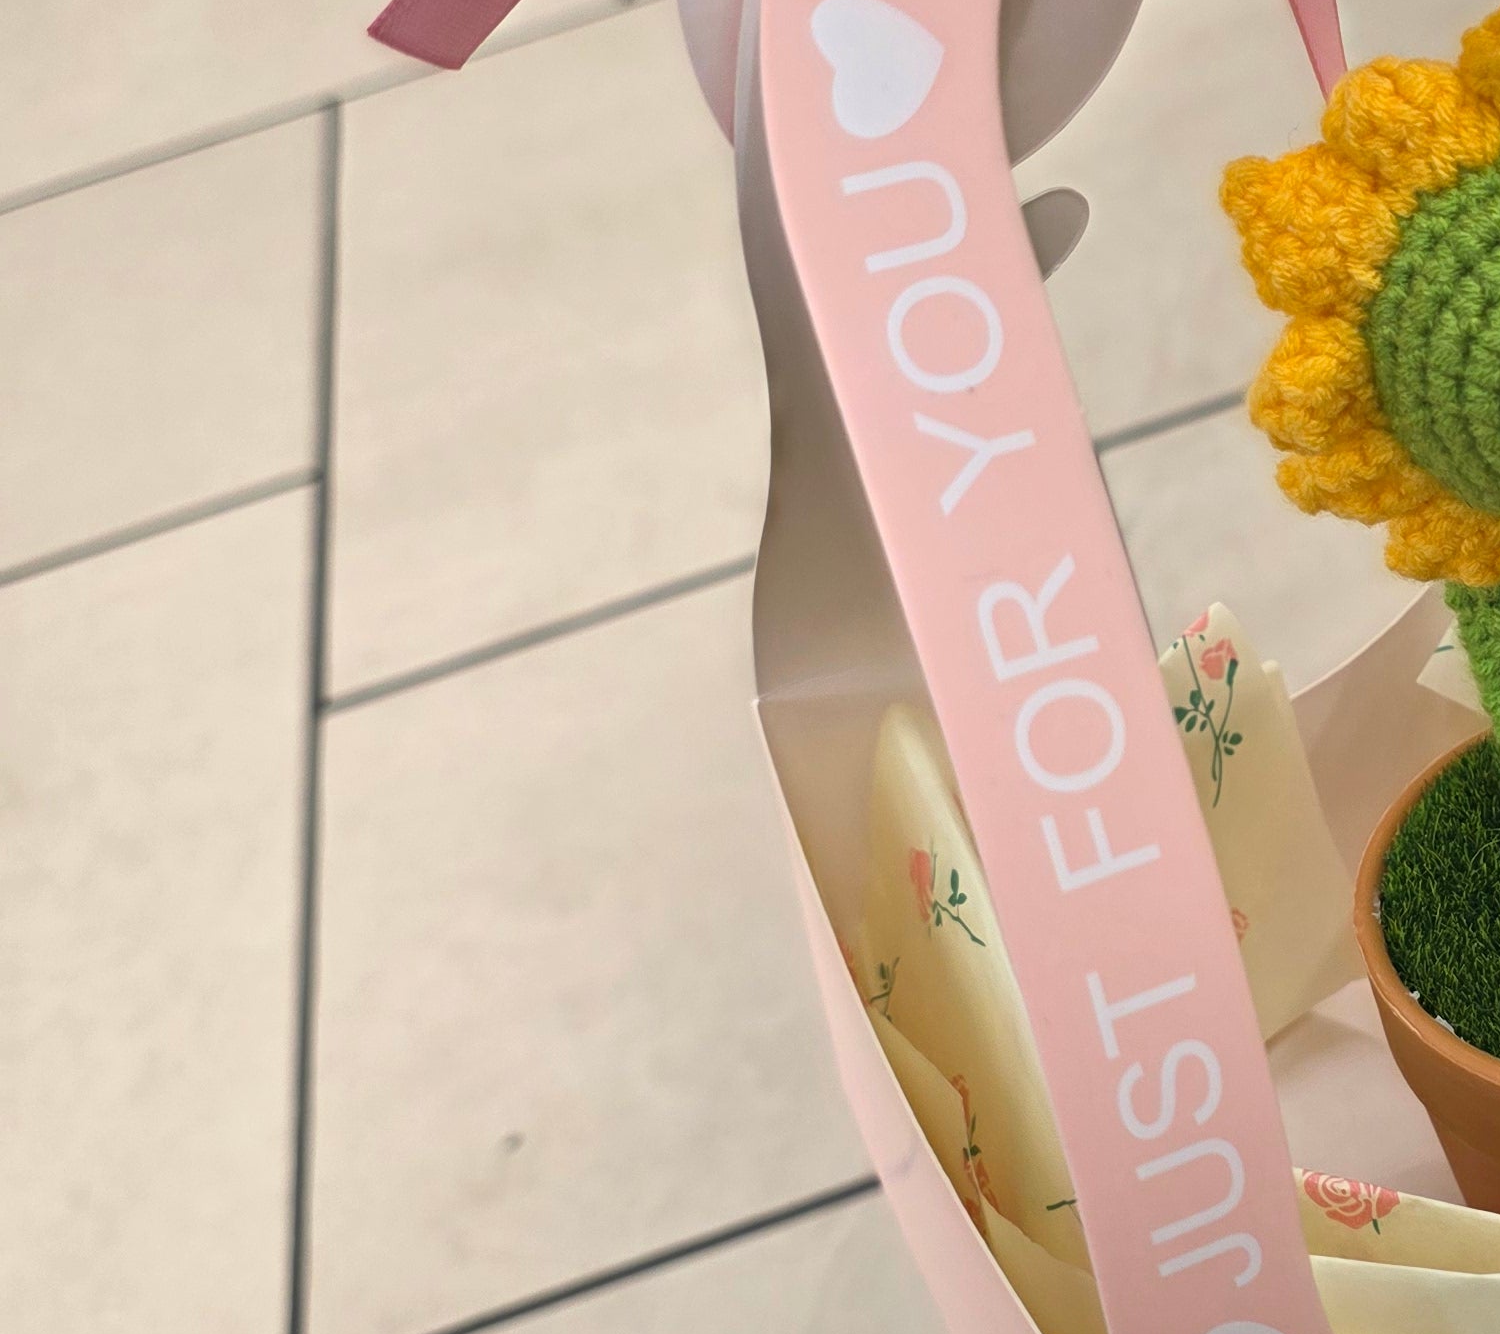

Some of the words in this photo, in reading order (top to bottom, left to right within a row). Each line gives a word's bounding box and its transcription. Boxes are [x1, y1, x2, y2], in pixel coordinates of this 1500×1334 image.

[841, 160, 1037, 518] YOU
[977, 553, 1162, 894] FOR
[1085, 971, 1264, 1288] JUST
